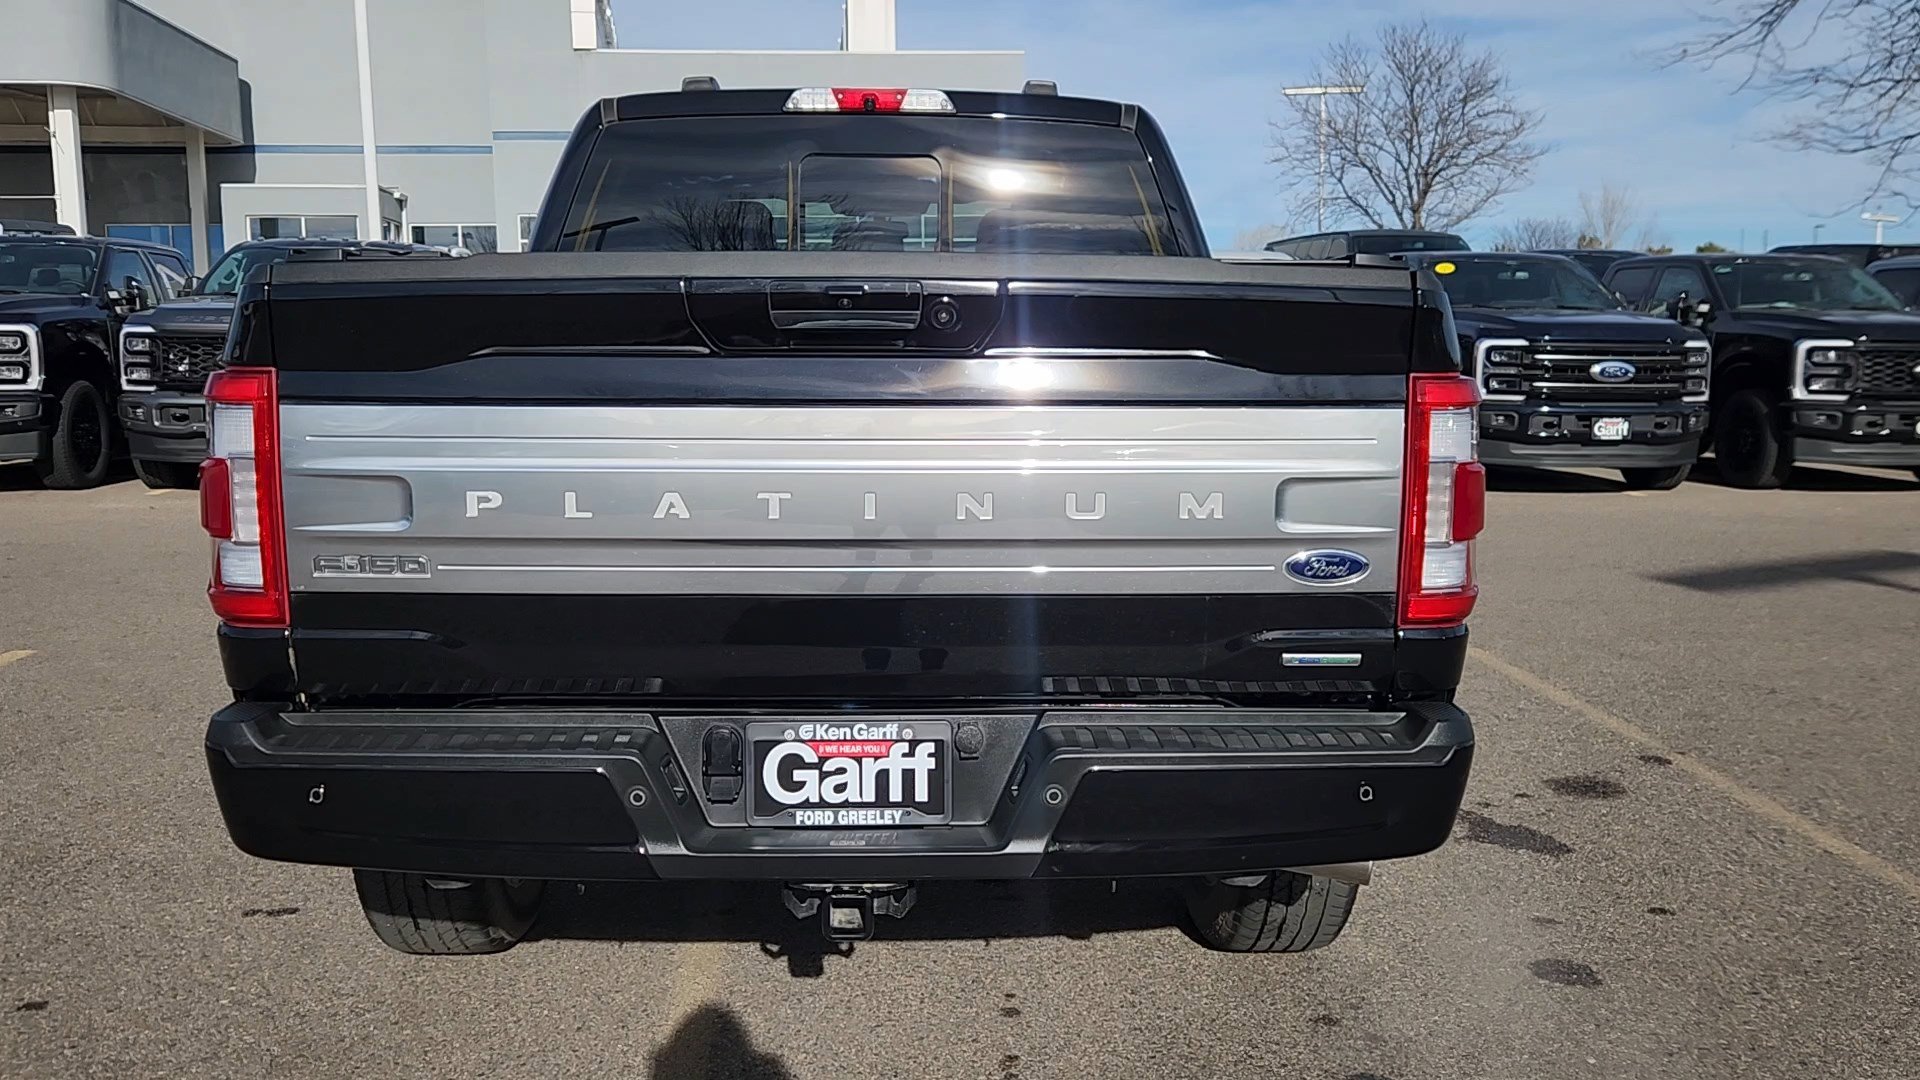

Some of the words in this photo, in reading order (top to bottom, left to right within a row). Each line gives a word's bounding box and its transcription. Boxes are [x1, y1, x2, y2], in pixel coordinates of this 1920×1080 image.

[465, 491, 1224, 520] PLATINUM
[815, 723, 851, 740] Ken
[852, 723, 899, 740] Garff
[825, 745, 838, 753] WE
[840, 745, 861, 753] HEAR
[863, 745, 880, 753] YOU
[762, 741, 936, 805] Garff
[795, 810, 834, 825] FORD
[838, 810, 902, 825] GREELEY
